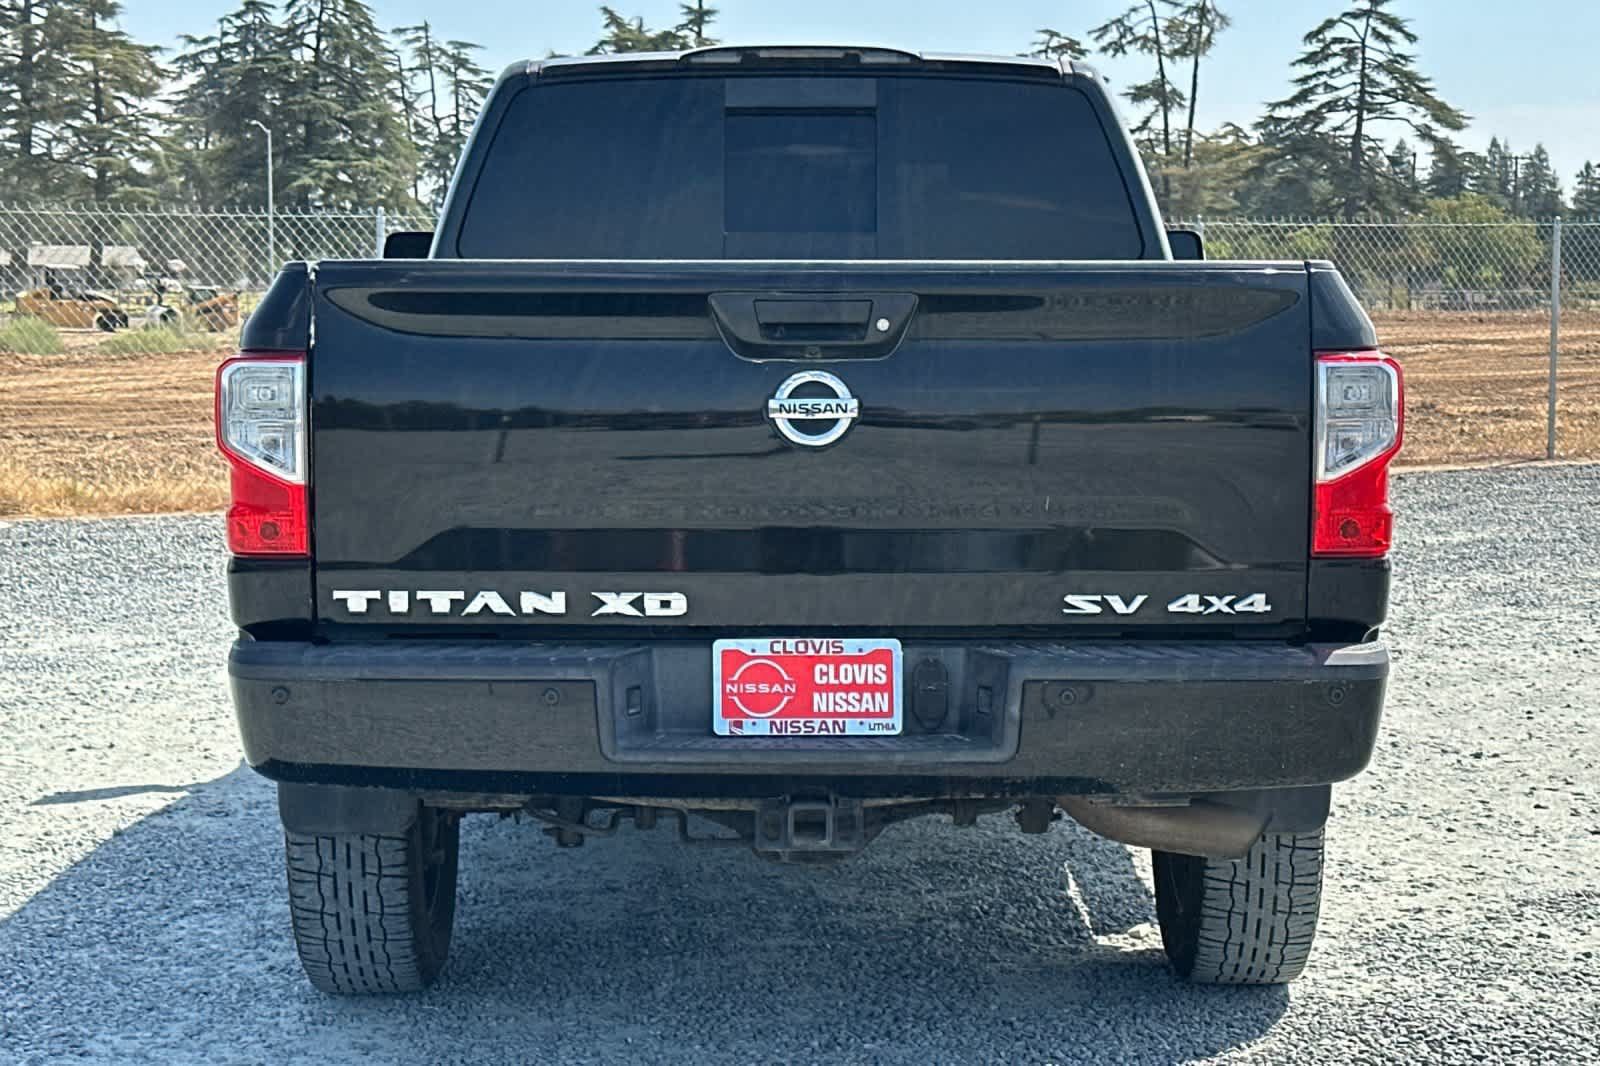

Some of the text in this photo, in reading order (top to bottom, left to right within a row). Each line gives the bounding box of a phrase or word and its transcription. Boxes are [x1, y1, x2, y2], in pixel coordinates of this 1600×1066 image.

[779, 403, 848, 414] NISSAN
[333, 590, 688, 617] TITAN XD
[1062, 594, 1149, 614] SV
[769, 640, 844, 654] CLOVIS
[814, 663, 887, 685] CLOVIS
[726, 683, 796, 693] NISSAN
[813, 692, 889, 713] NISSAN
[769, 720, 846, 734] NISSAN
